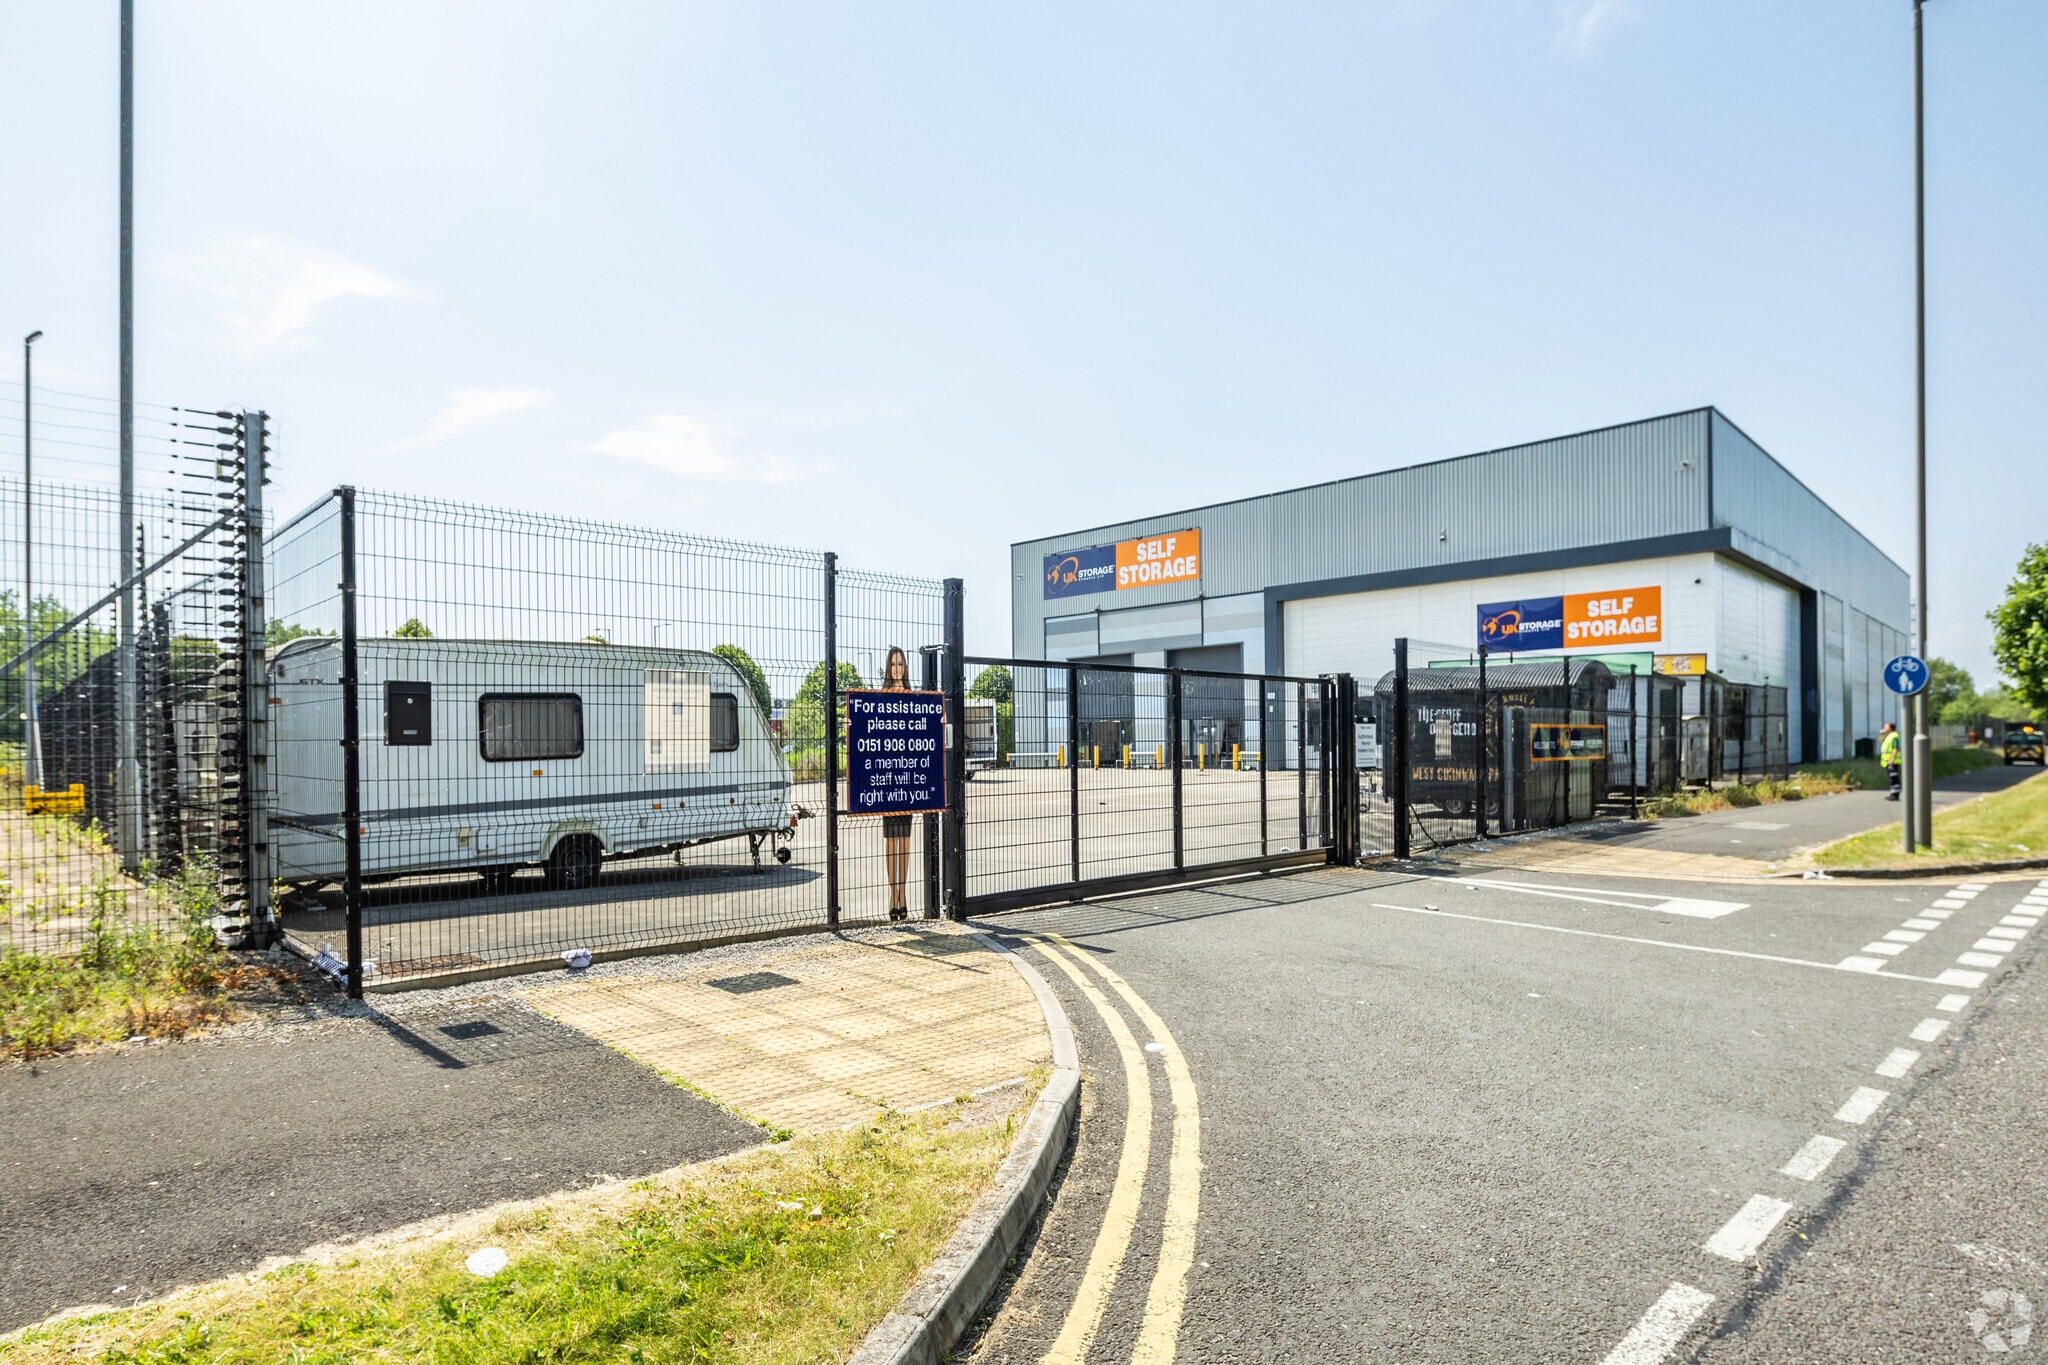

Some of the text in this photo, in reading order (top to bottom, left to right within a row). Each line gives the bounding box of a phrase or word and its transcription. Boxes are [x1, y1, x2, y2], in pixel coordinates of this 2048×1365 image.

[1137, 538, 1176, 562] SELF
[1063, 572, 1077, 583] UK
[1079, 565, 1114, 578] STORAGE
[1119, 556, 1196, 585] STORAGE
[1588, 597, 1634, 617] SELF
[1501, 624, 1518, 634] UK
[1519, 619, 1561, 631] STORAGE
[1568, 616, 1657, 639] STORAGE
[877, 700, 942, 714] assistance
[868, 717, 926, 733] please call
[857, 738, 935, 751] 0151 908 0800
[864, 755, 930, 769] a member of
[869, 772, 926, 786] staff will be
[860, 789, 883, 806] right
[886, 788, 907, 802] with
